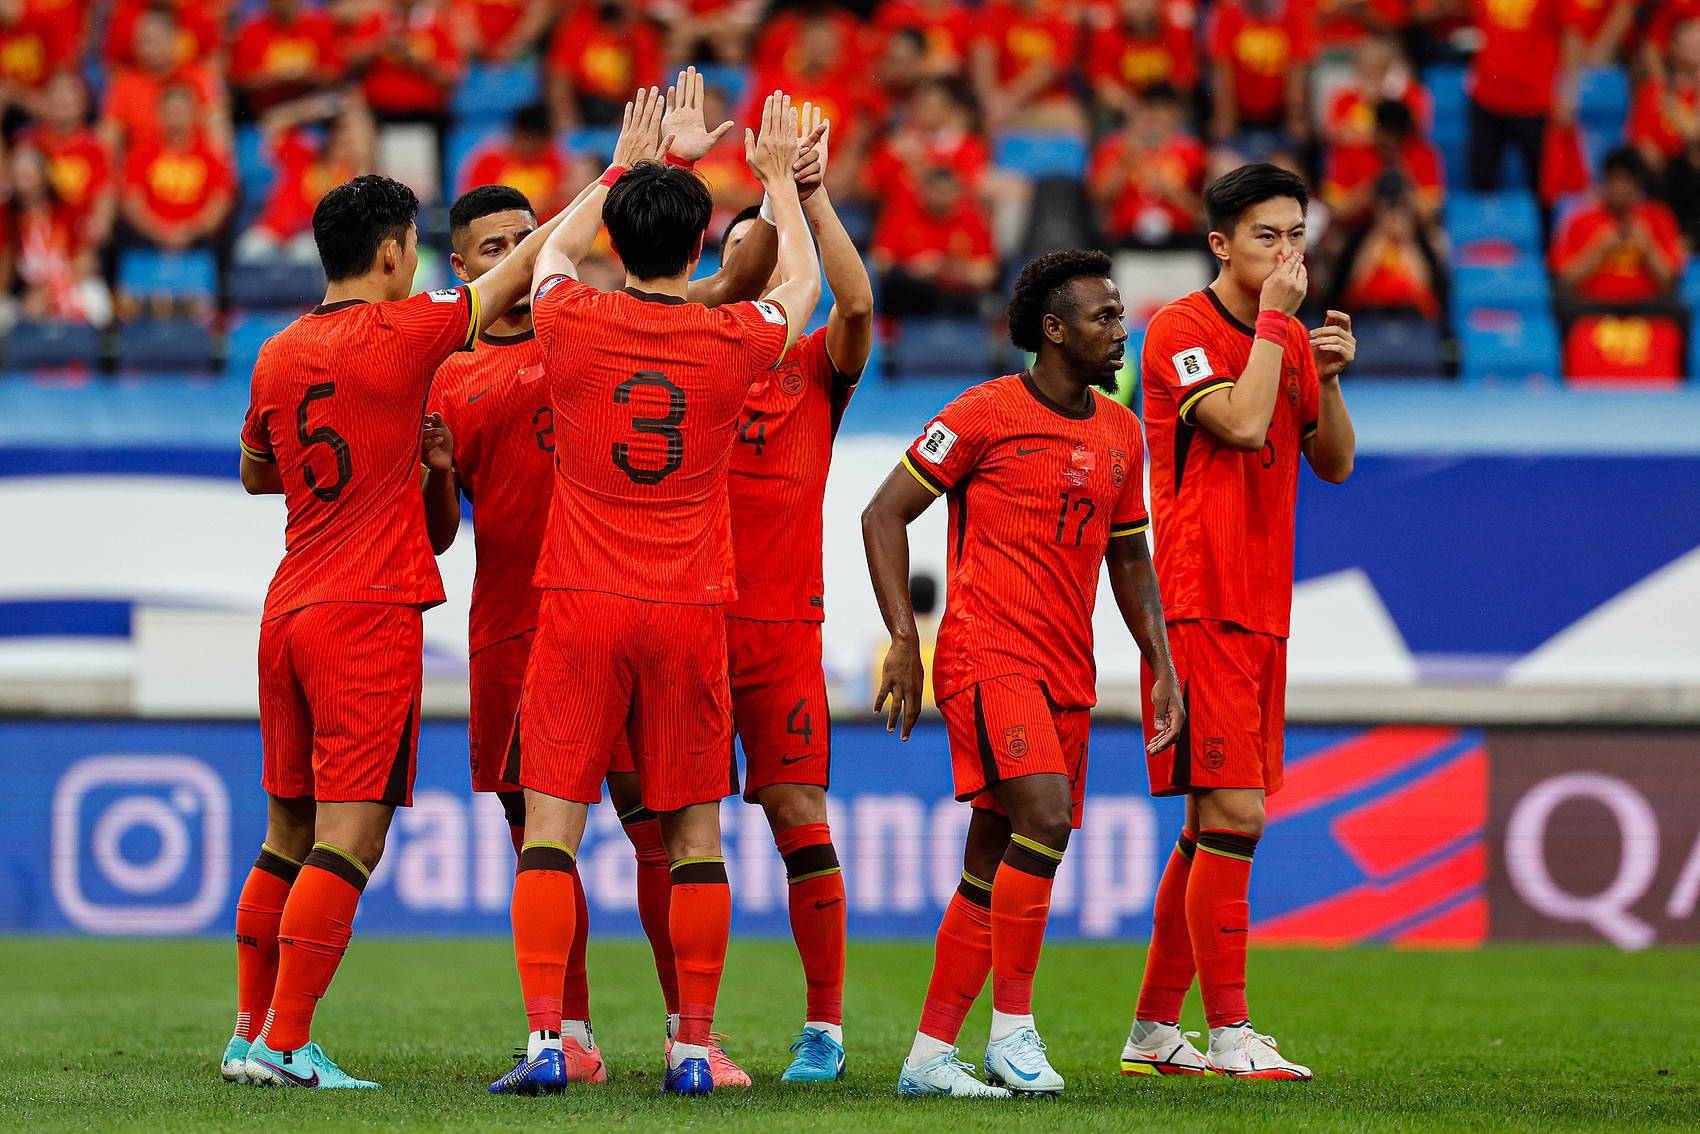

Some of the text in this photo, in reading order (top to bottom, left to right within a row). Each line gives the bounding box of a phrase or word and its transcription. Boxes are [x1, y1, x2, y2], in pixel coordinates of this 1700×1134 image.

[297, 381, 353, 502] 5
[533, 407, 555, 453] 2
[612, 370, 686, 485] 3
[741, 411, 766, 455] 4
[1056, 493, 1096, 546] 17
[788, 698, 813, 745] 4
